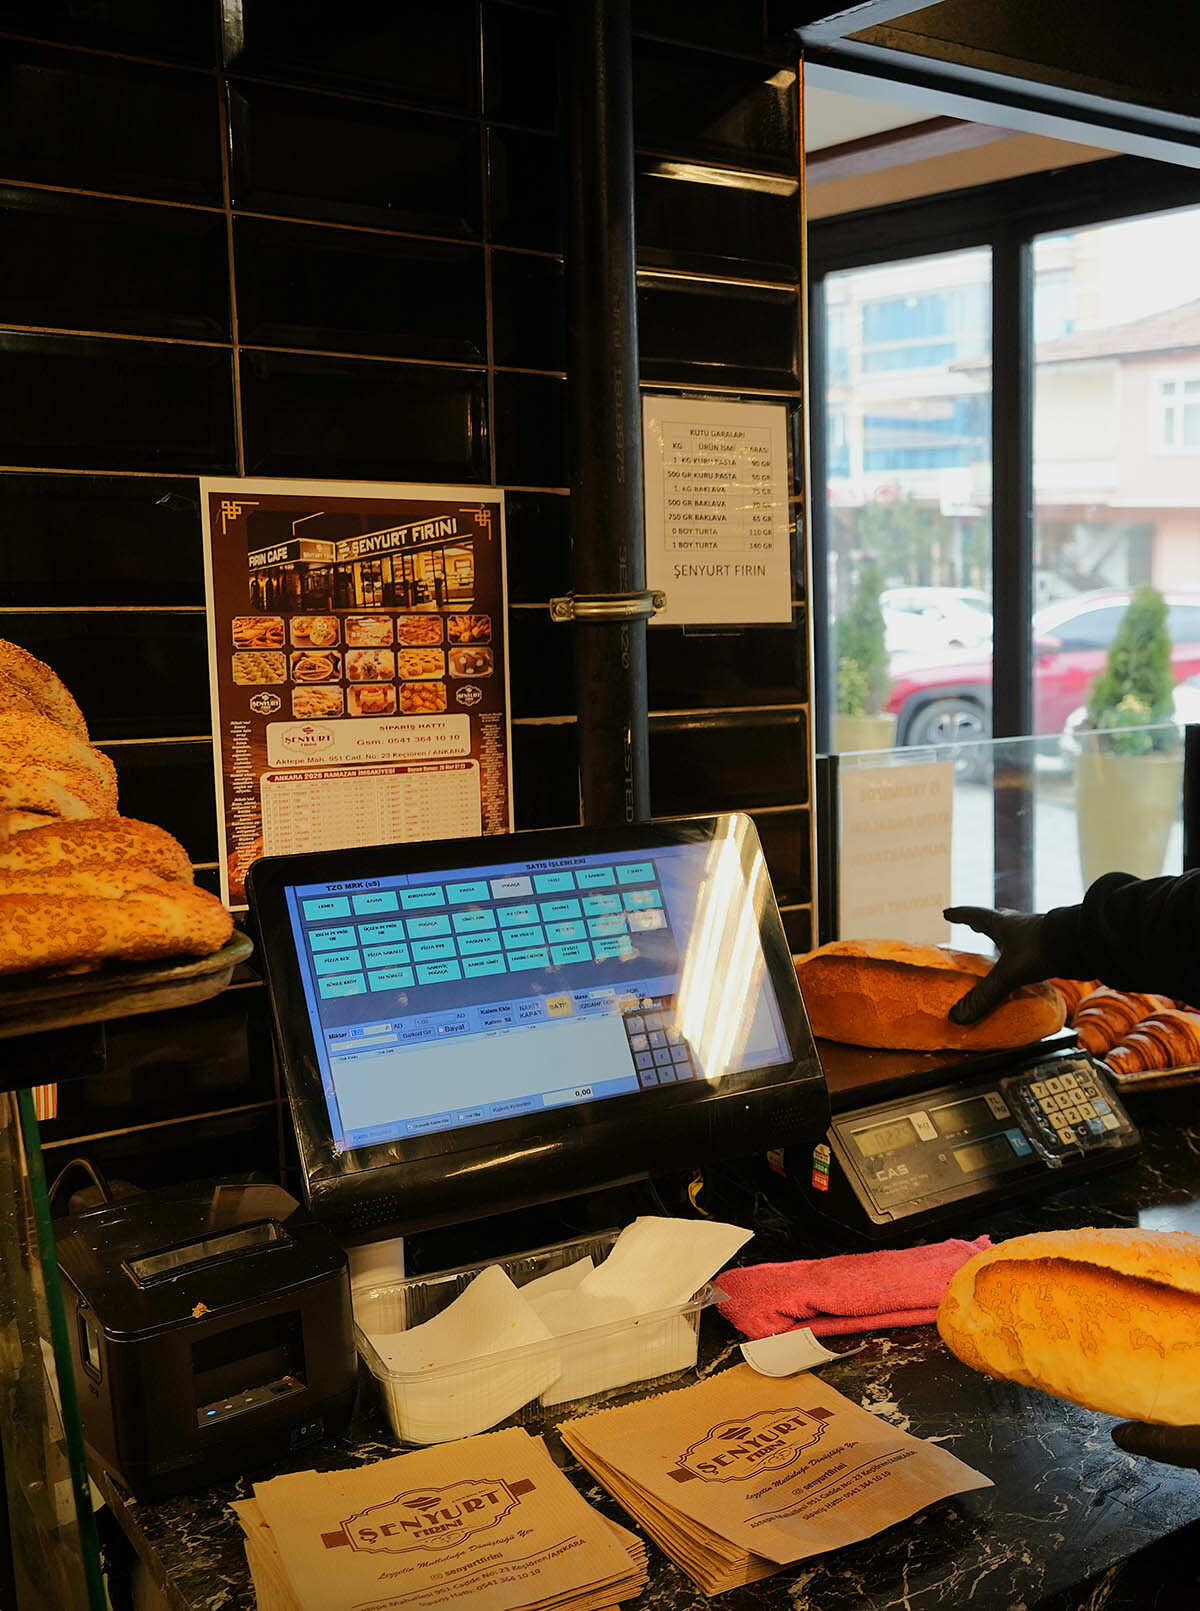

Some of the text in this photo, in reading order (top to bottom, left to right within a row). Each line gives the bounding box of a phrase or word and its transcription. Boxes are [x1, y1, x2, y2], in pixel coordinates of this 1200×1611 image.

[694, 500, 727, 508] BAKLAVA
[695, 514, 727, 522] BAKLAVA
[412, 517, 457, 543] FIRINI
[266, 546, 288, 563] CAFE
[673, 564, 766, 579] ŞENYURT FIRIN
[275, 758, 304, 766] Aktepe
[274, 774, 303, 782] ANKARA
[324, 770, 357, 779] RAMAZAN
[345, 882, 364, 890] MRK
[575, 1088, 591, 1098] 0,00
[917, 1122, 930, 1130] kg
[876, 1164, 910, 1182] CAS
[696, 1416, 808, 1475] ŞENYURT
[746, 1440, 787, 1463] FIRINI
[357, 1489, 500, 1545] ŞENYURT
[412, 1518, 464, 1539] FIRINI
[453, 1575, 482, 1590] Cadde
[500, 1565, 511, 1575] 23
[475, 1578, 499, 1592] 0541
[530, 1567, 542, 1578] 10
